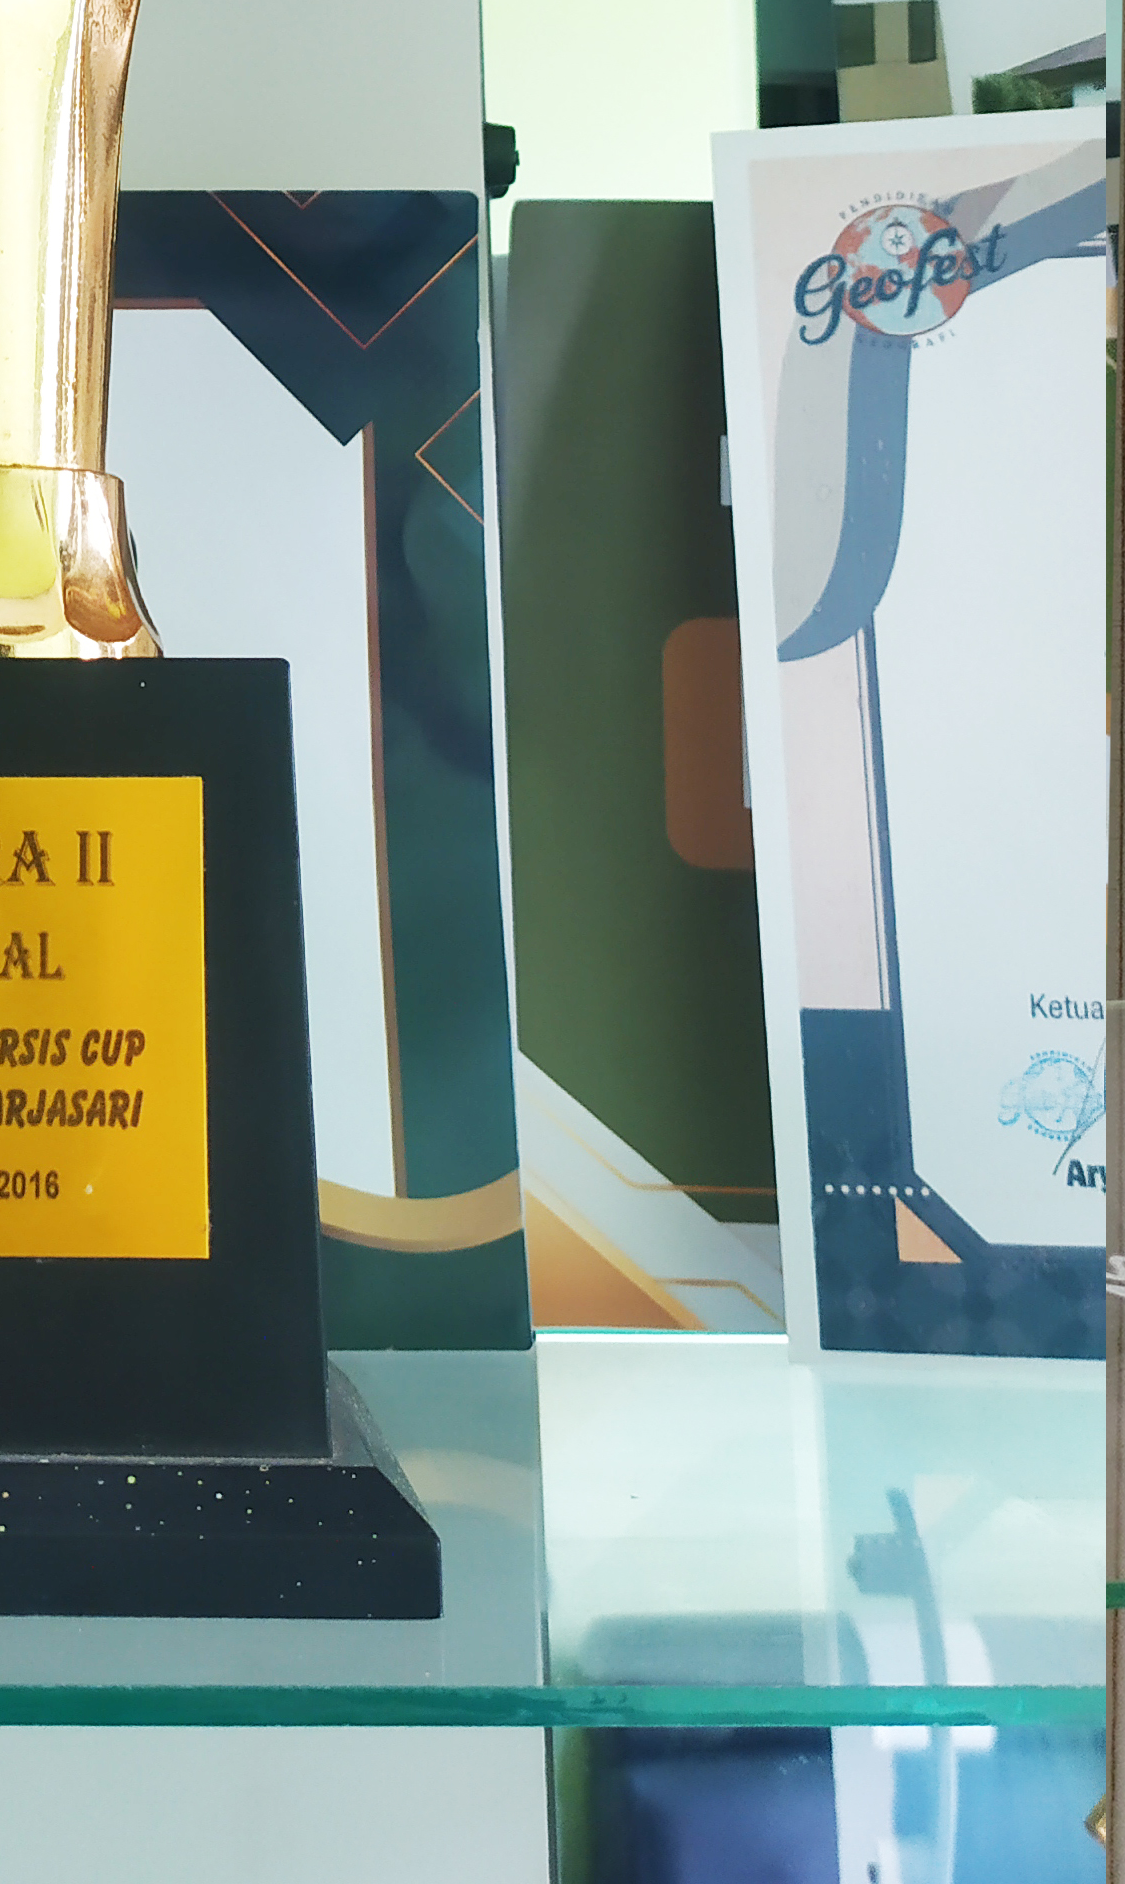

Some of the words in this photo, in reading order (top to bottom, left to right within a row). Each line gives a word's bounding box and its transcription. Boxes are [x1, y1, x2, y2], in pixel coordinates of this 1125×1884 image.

[794, 223, 1008, 346] Geofest
[75, 829, 115, 887] II
[1029, 992, 1104, 1020] Ketua
[80, 1028, 146, 1067] CUP
